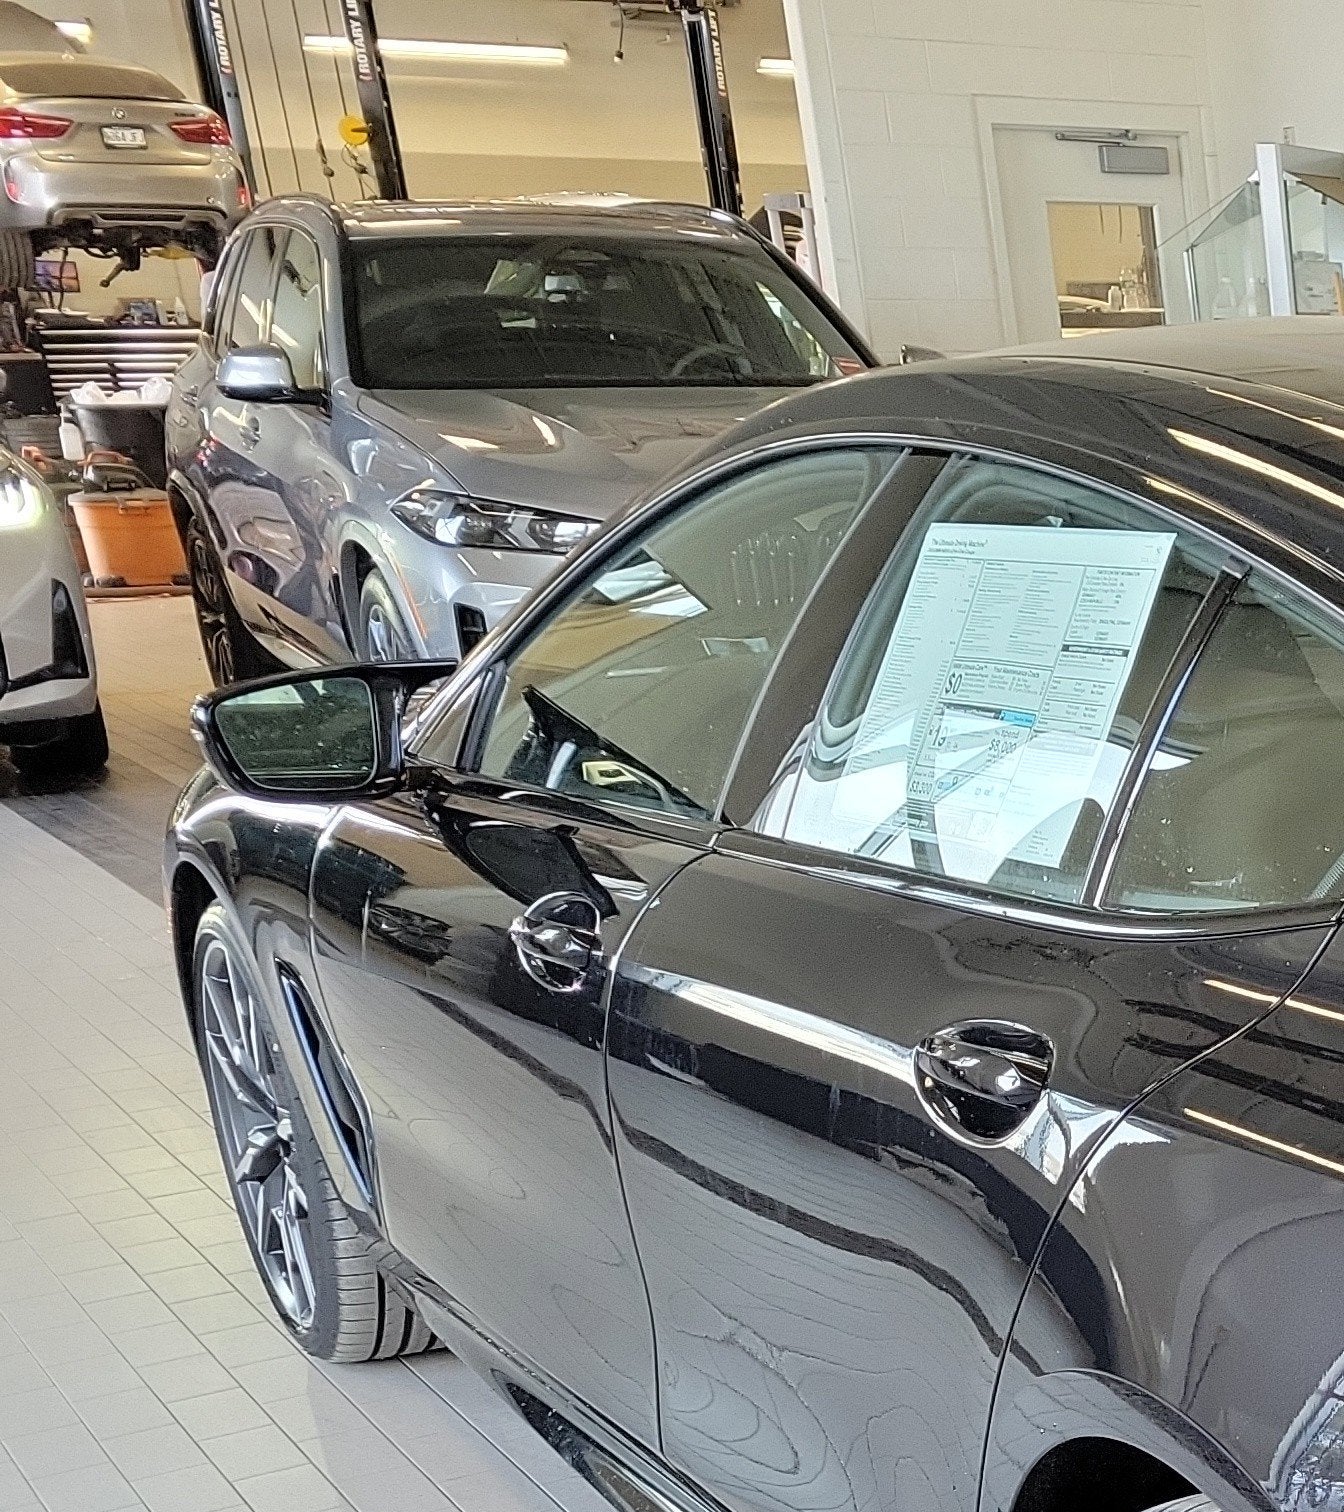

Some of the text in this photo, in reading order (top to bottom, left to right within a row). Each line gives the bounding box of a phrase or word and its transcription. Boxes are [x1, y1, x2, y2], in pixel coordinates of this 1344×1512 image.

[211, 10, 231, 68] ROTARY
[351, 20, 371, 74] ROTARY
[711, 39, 726, 90] ROTARY
[945, 672, 962, 694] $0
